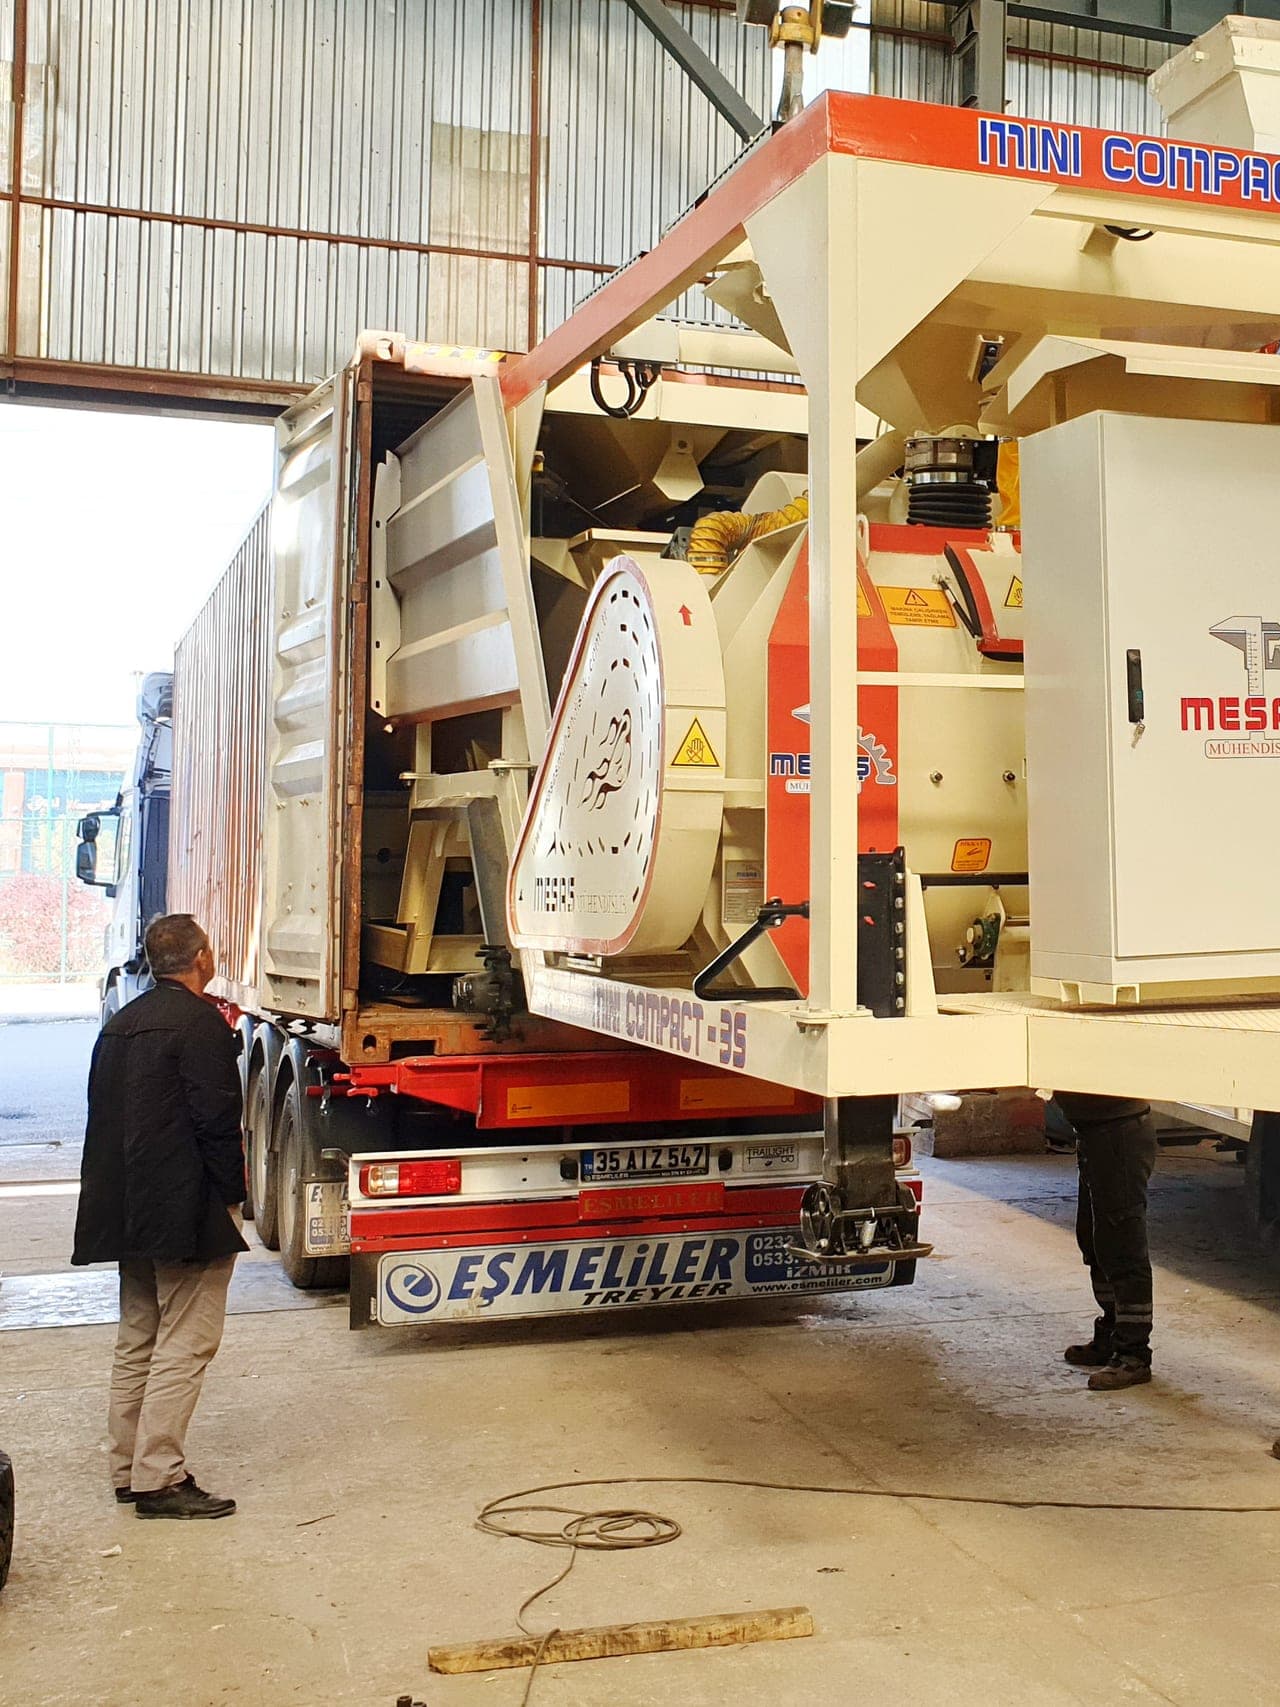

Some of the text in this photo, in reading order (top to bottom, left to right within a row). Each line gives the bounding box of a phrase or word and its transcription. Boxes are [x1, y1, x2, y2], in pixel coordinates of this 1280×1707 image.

[977, 117, 1083, 178] MINI
[625, 988, 704, 1057] COMPACT
[596, 1150, 620, 1172] 35
[667, 1145, 704, 1168] 547
[582, 1282, 734, 1306] TREYLER
[751, 1275, 883, 1293] www.esmeliler.com
